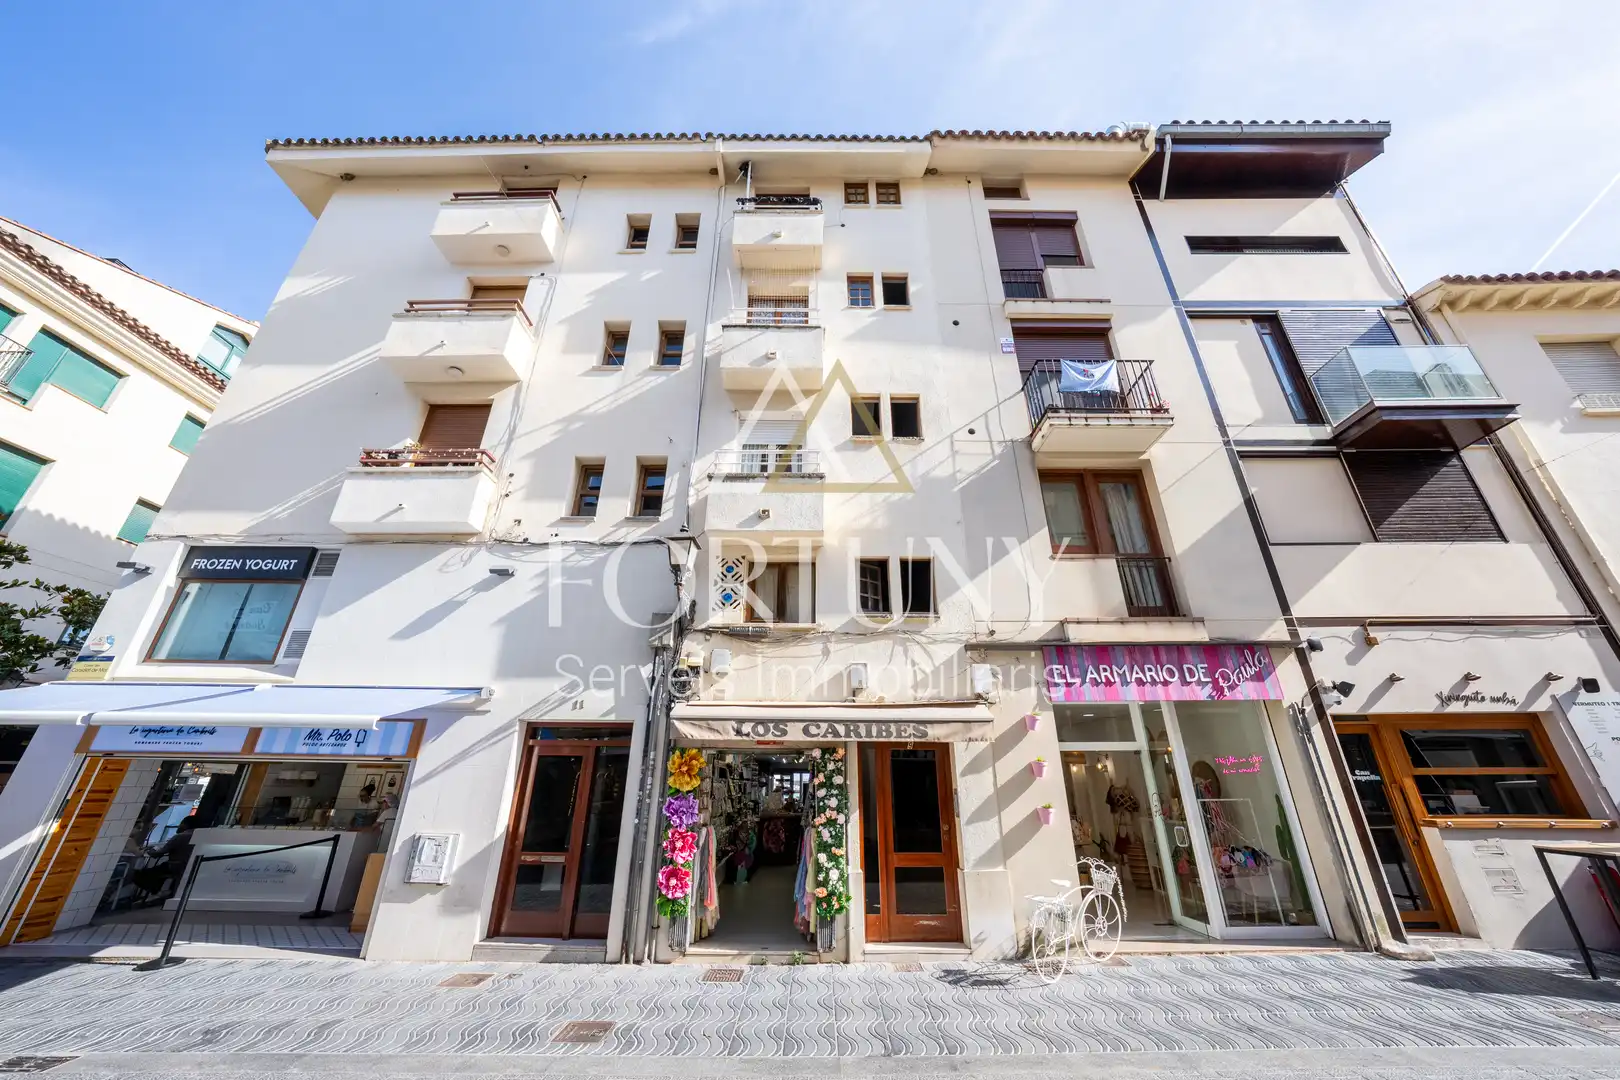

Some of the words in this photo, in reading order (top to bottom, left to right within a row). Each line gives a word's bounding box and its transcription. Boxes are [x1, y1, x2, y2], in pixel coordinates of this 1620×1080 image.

[190, 558, 242, 570] FROZEN
[244, 559, 298, 570] YOGURT
[1053, 664, 1079, 684] EL
[1085, 663, 1180, 683] ARMARIO
[1183, 663, 1212, 682] DE
[1214, 649, 1269, 692] Paula
[571, 699, 584, 711] 11
[303, 728, 323, 742] Mr.
[327, 728, 352, 742] Polo
[732, 720, 788, 738] LOS
[802, 722, 929, 739] CARIBES
[1350, 774, 1381, 782] rapella
